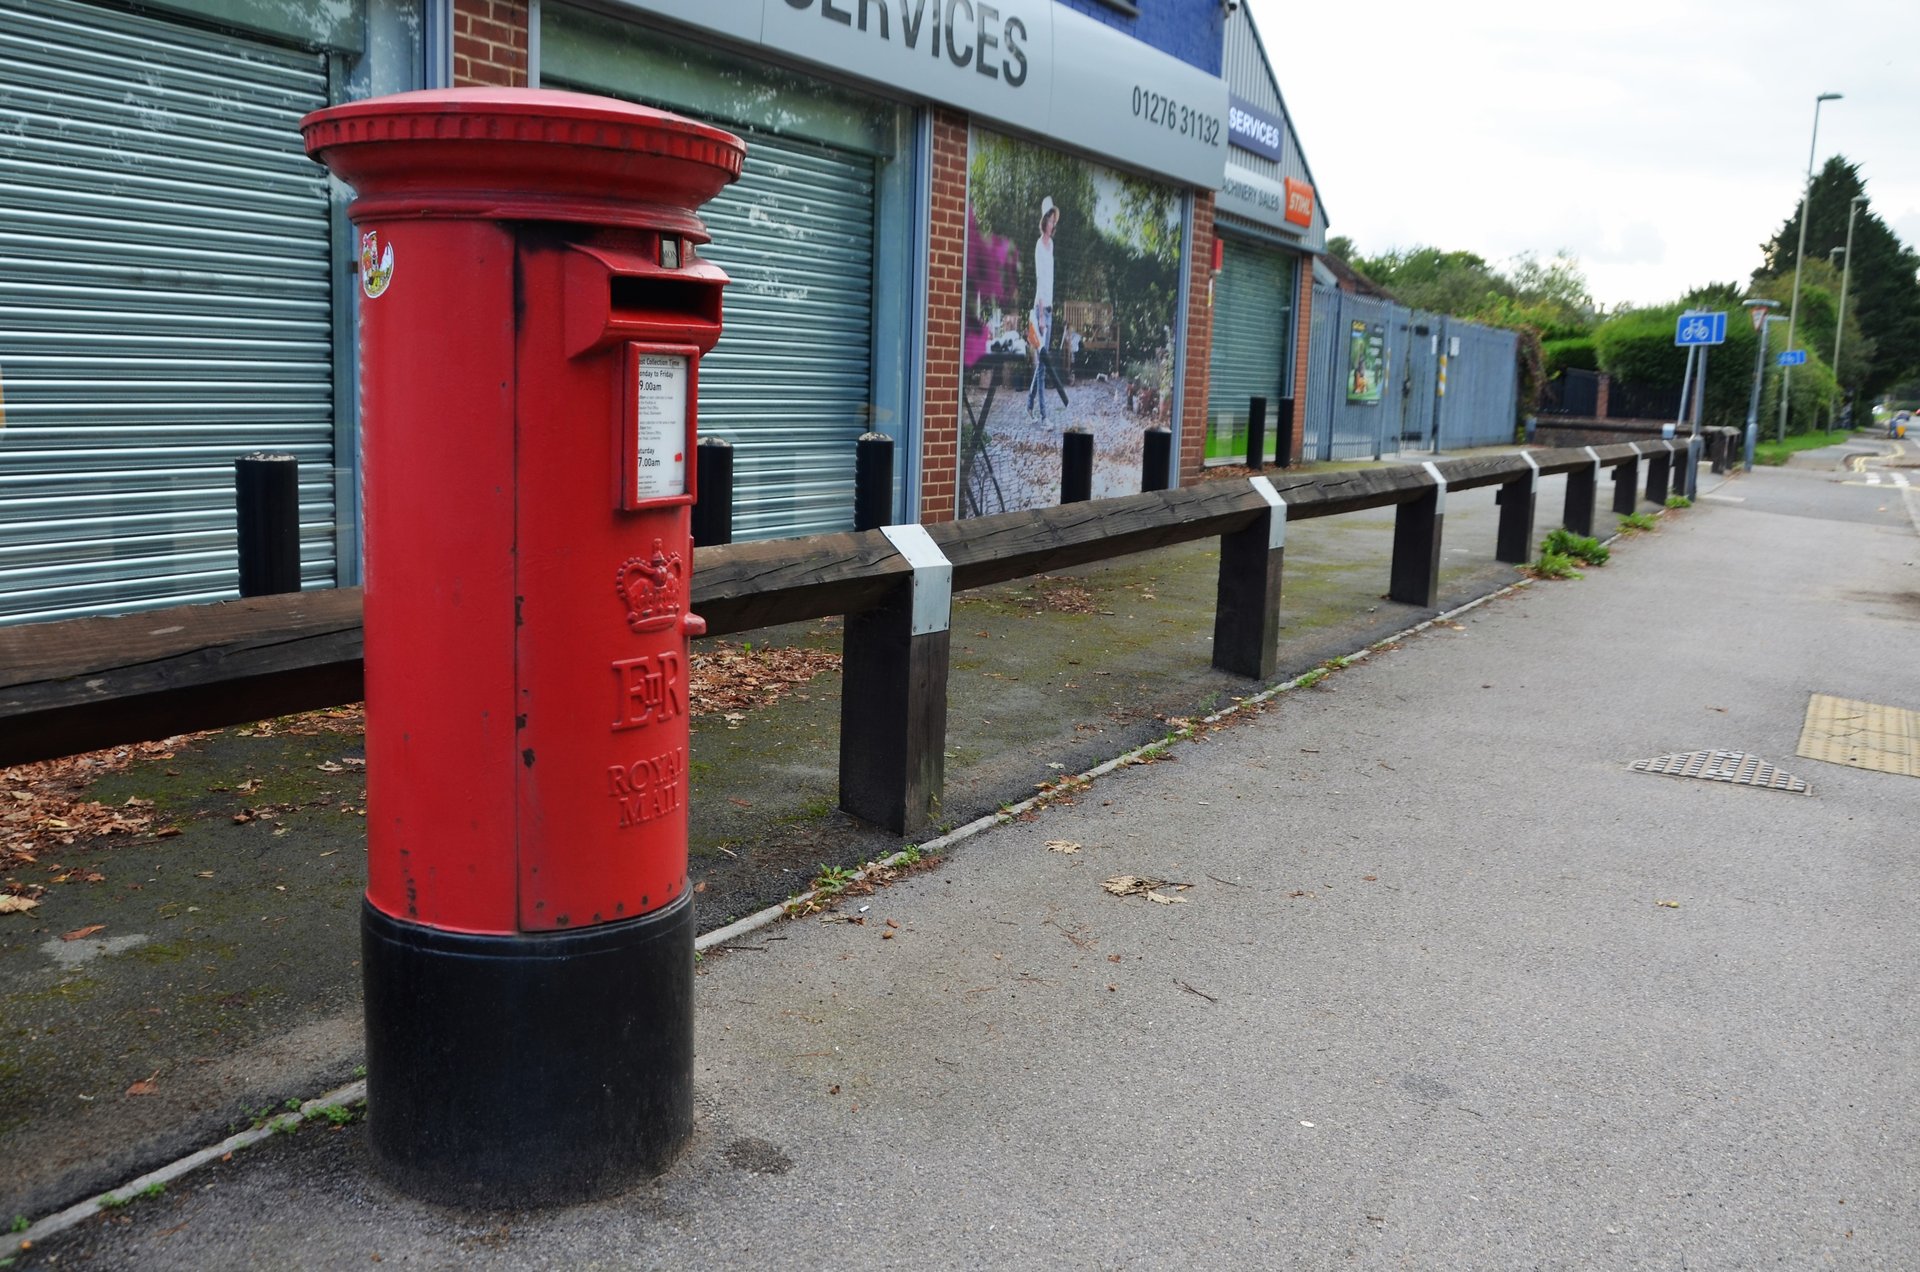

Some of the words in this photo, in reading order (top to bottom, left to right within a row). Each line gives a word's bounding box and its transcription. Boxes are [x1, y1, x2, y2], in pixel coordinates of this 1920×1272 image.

[783, 0, 1028, 88] VICES
[1132, 86, 1176, 129] 01276
[1179, 105, 1220, 147] 31132
[1229, 107, 1279, 149] SERVICES
[1258, 189, 1280, 213] SALES
[1289, 192, 1311, 215] STIHL
[647, 357, 668, 367] Collection
[654, 370, 659, 378] to
[660, 370, 673, 379] Friday
[607, 746, 684, 800] ROYAL
[618, 781, 681, 829] MAIL
